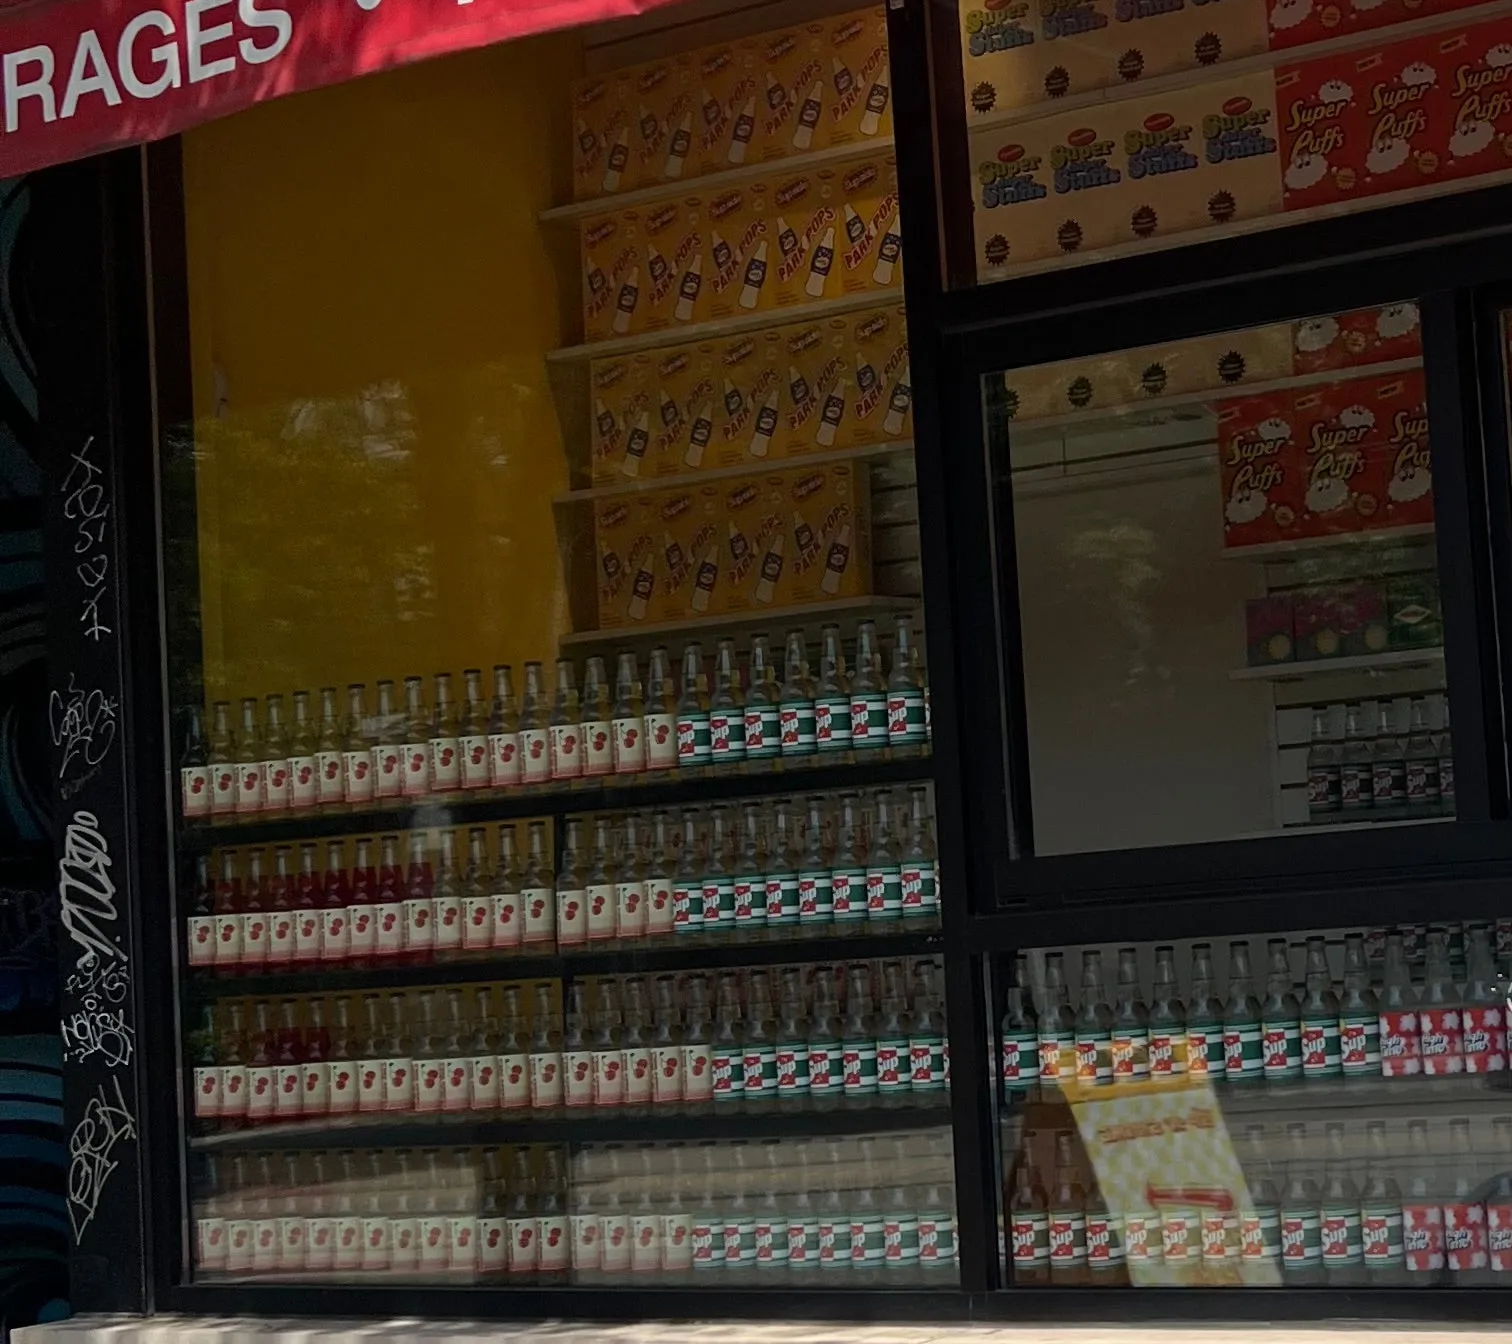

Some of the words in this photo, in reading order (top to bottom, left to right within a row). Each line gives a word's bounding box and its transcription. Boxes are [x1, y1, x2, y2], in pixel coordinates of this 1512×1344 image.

[1453, 64, 1512, 97] Super
[1370, 82, 1429, 114] Super
[1458, 91, 1512, 130] Puffs
[765, 100, 794, 135] PARK
[1373, 111, 1426, 148] Puffs
[779, 245, 805, 280] PARK
[845, 233, 873, 269] PARK
[1228, 436, 1286, 465] Super
[1309, 423, 1369, 454] Super
[1231, 464, 1284, 495] Puffs
[1313, 452, 1365, 482] Puffs
